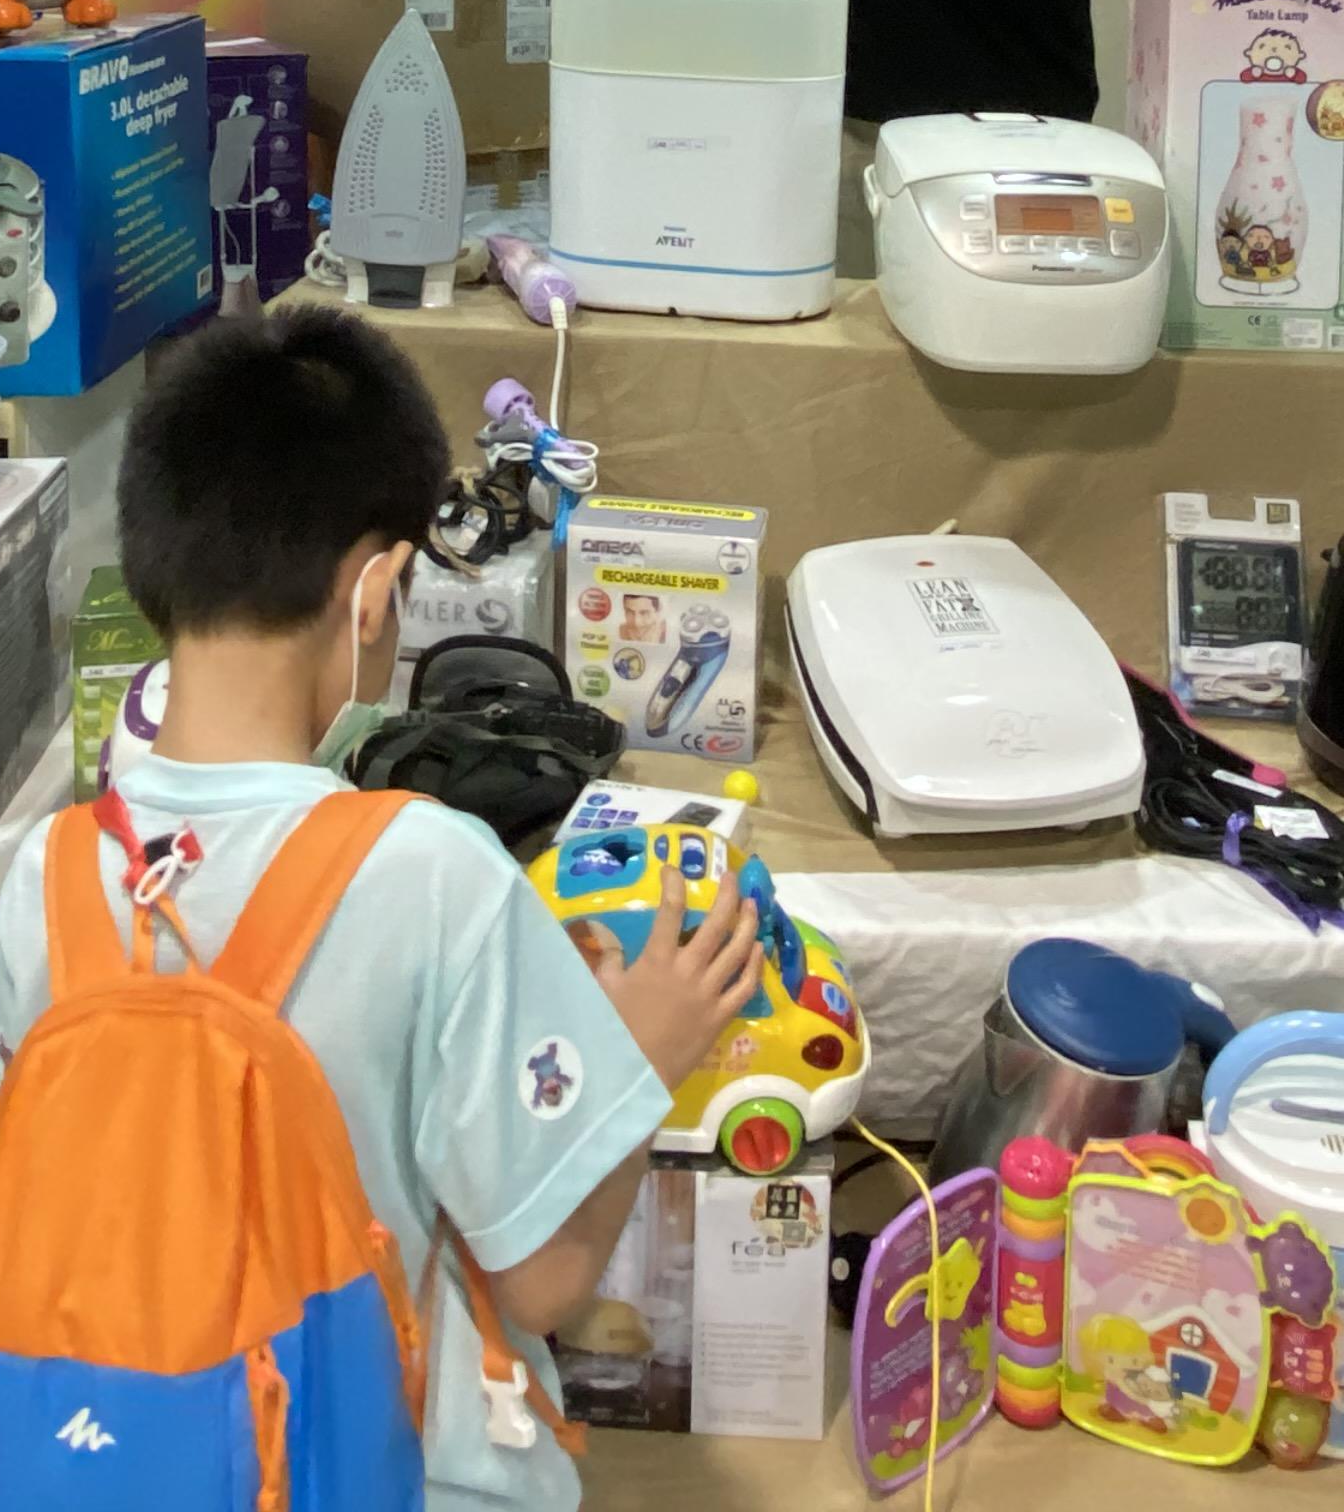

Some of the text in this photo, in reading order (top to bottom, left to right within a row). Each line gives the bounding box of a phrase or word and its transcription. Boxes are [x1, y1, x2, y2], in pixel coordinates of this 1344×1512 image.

[1247, 9, 1309, 23] Table Lamp
[79, 55, 129, 95] BRAVO
[110, 74, 189, 122] 3.0L detachable
[126, 102, 178, 137] deep fryer
[602, 569, 720, 590] RECHARGEABLE SHAVER
